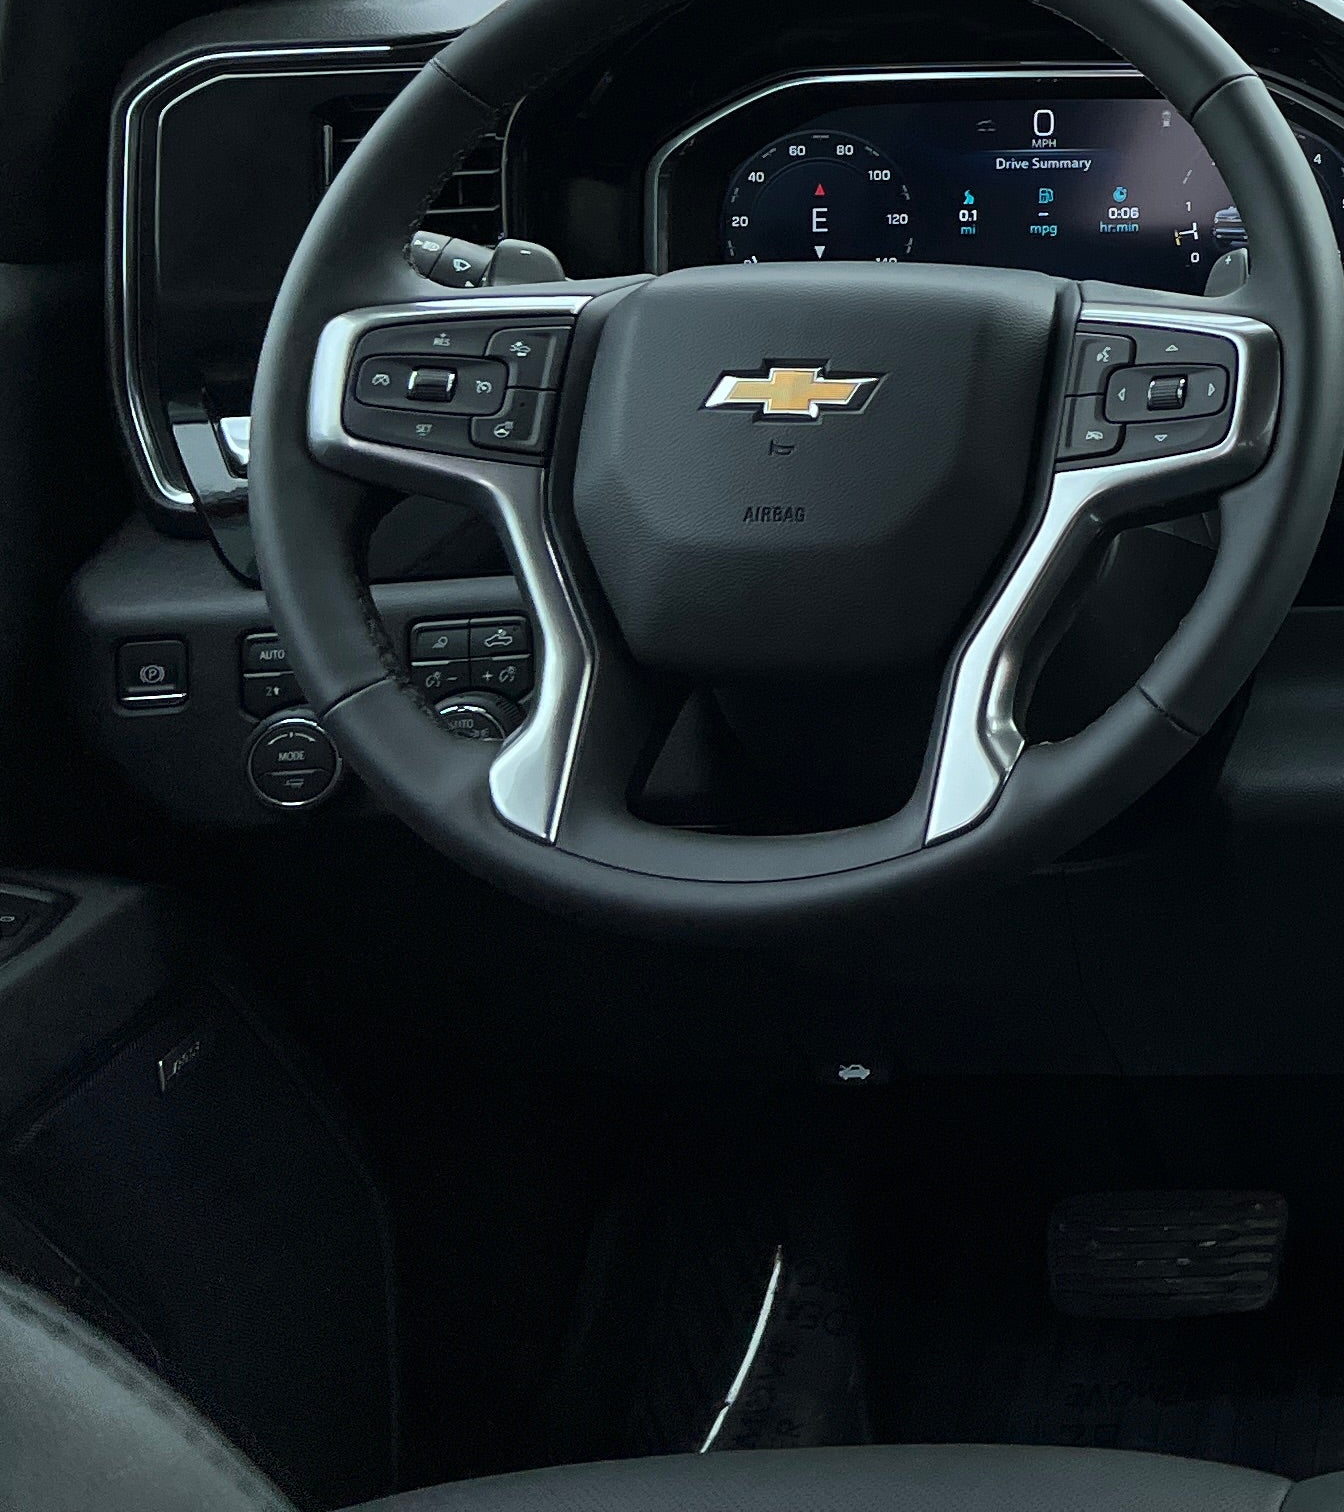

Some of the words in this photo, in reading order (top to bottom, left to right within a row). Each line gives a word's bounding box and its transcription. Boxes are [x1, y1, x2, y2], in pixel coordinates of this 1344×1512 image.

[1033, 109, 1055, 137] 0
[1031, 138, 1057, 149] MPH
[788, 145, 806, 156] 60
[836, 144, 854, 156] 80
[995, 157, 1029, 170] Drive
[1031, 158, 1092, 172] Summary
[1313, 153, 1322, 165] 4
[748, 171, 765, 183] 40
[868, 170, 891, 181] 100
[1185, 201, 1192, 212] 1
[812, 207, 829, 232] E
[886, 213, 909, 225] 120
[958, 209, 978, 222] 0.1
[1108, 207, 1140, 220] 0:06
[731, 216, 749, 227] 20
[960, 224, 976, 235] mi
[1030, 224, 1058, 237] mpg
[1190, 252, 1200, 263] 0
[742, 506, 806, 524] AIRBAG
[259, 649, 286, 660] AUTO
[277, 751, 306, 762] MODE
